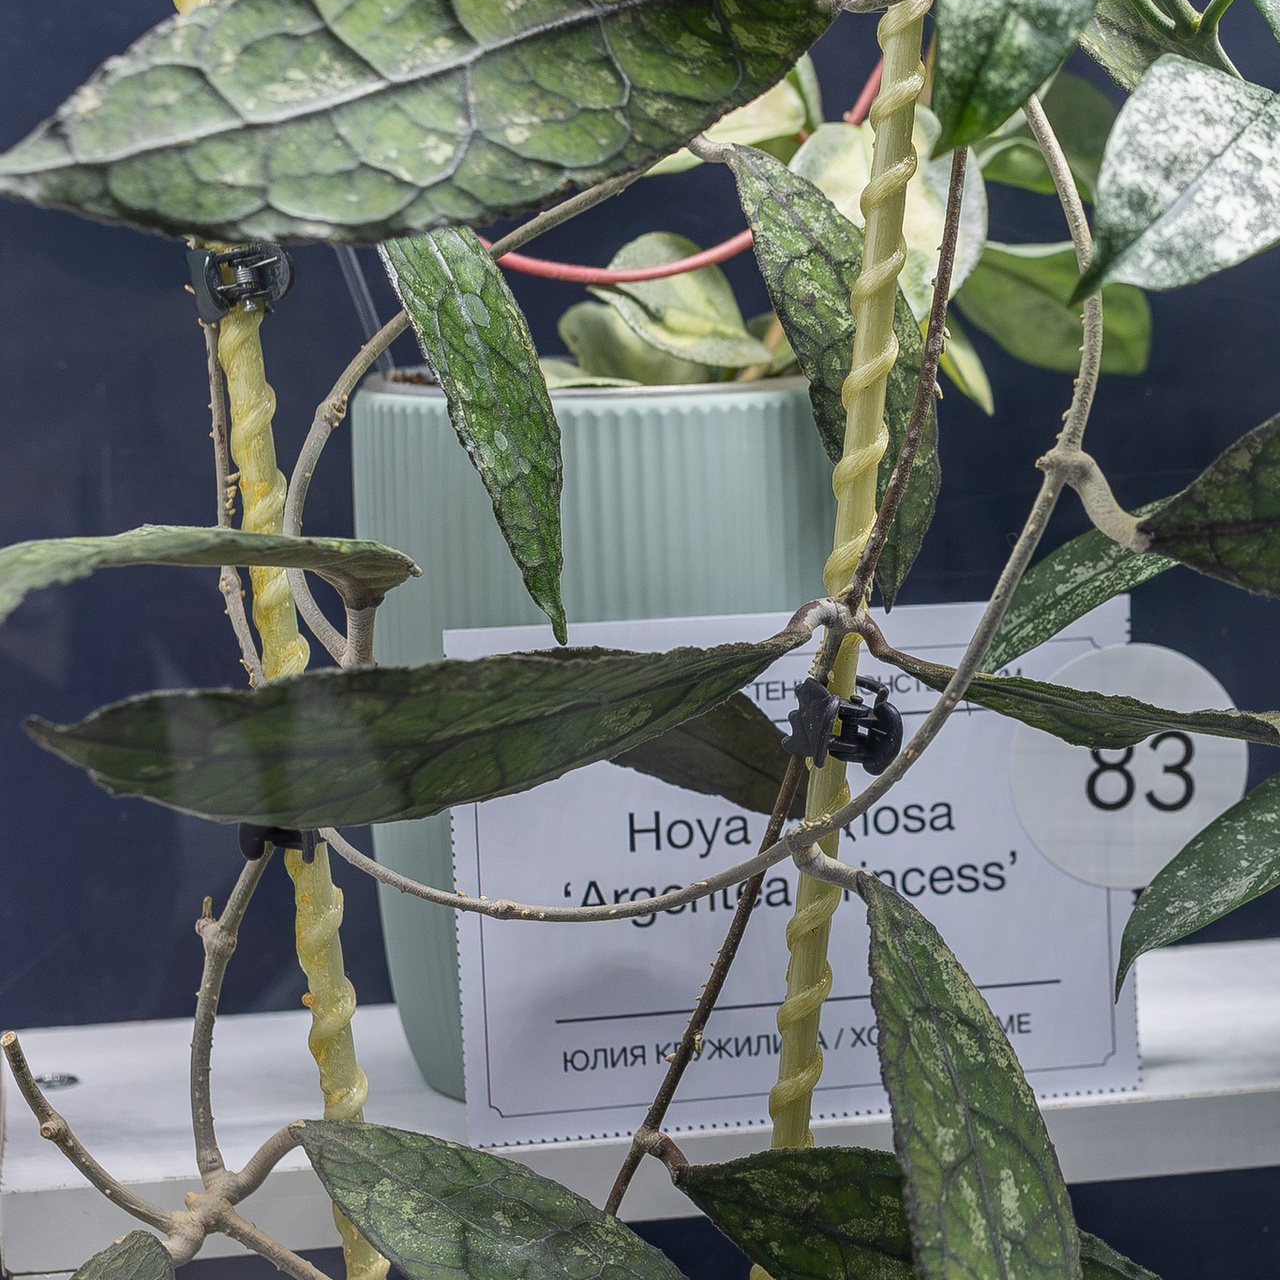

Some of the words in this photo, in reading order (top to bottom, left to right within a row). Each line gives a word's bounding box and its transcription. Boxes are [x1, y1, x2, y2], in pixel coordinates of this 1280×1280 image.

[1086, 730, 1195, 812] 83
[628, 810, 752, 859] Hoya
[562, 1044, 648, 1073] ЮЛИЯ
